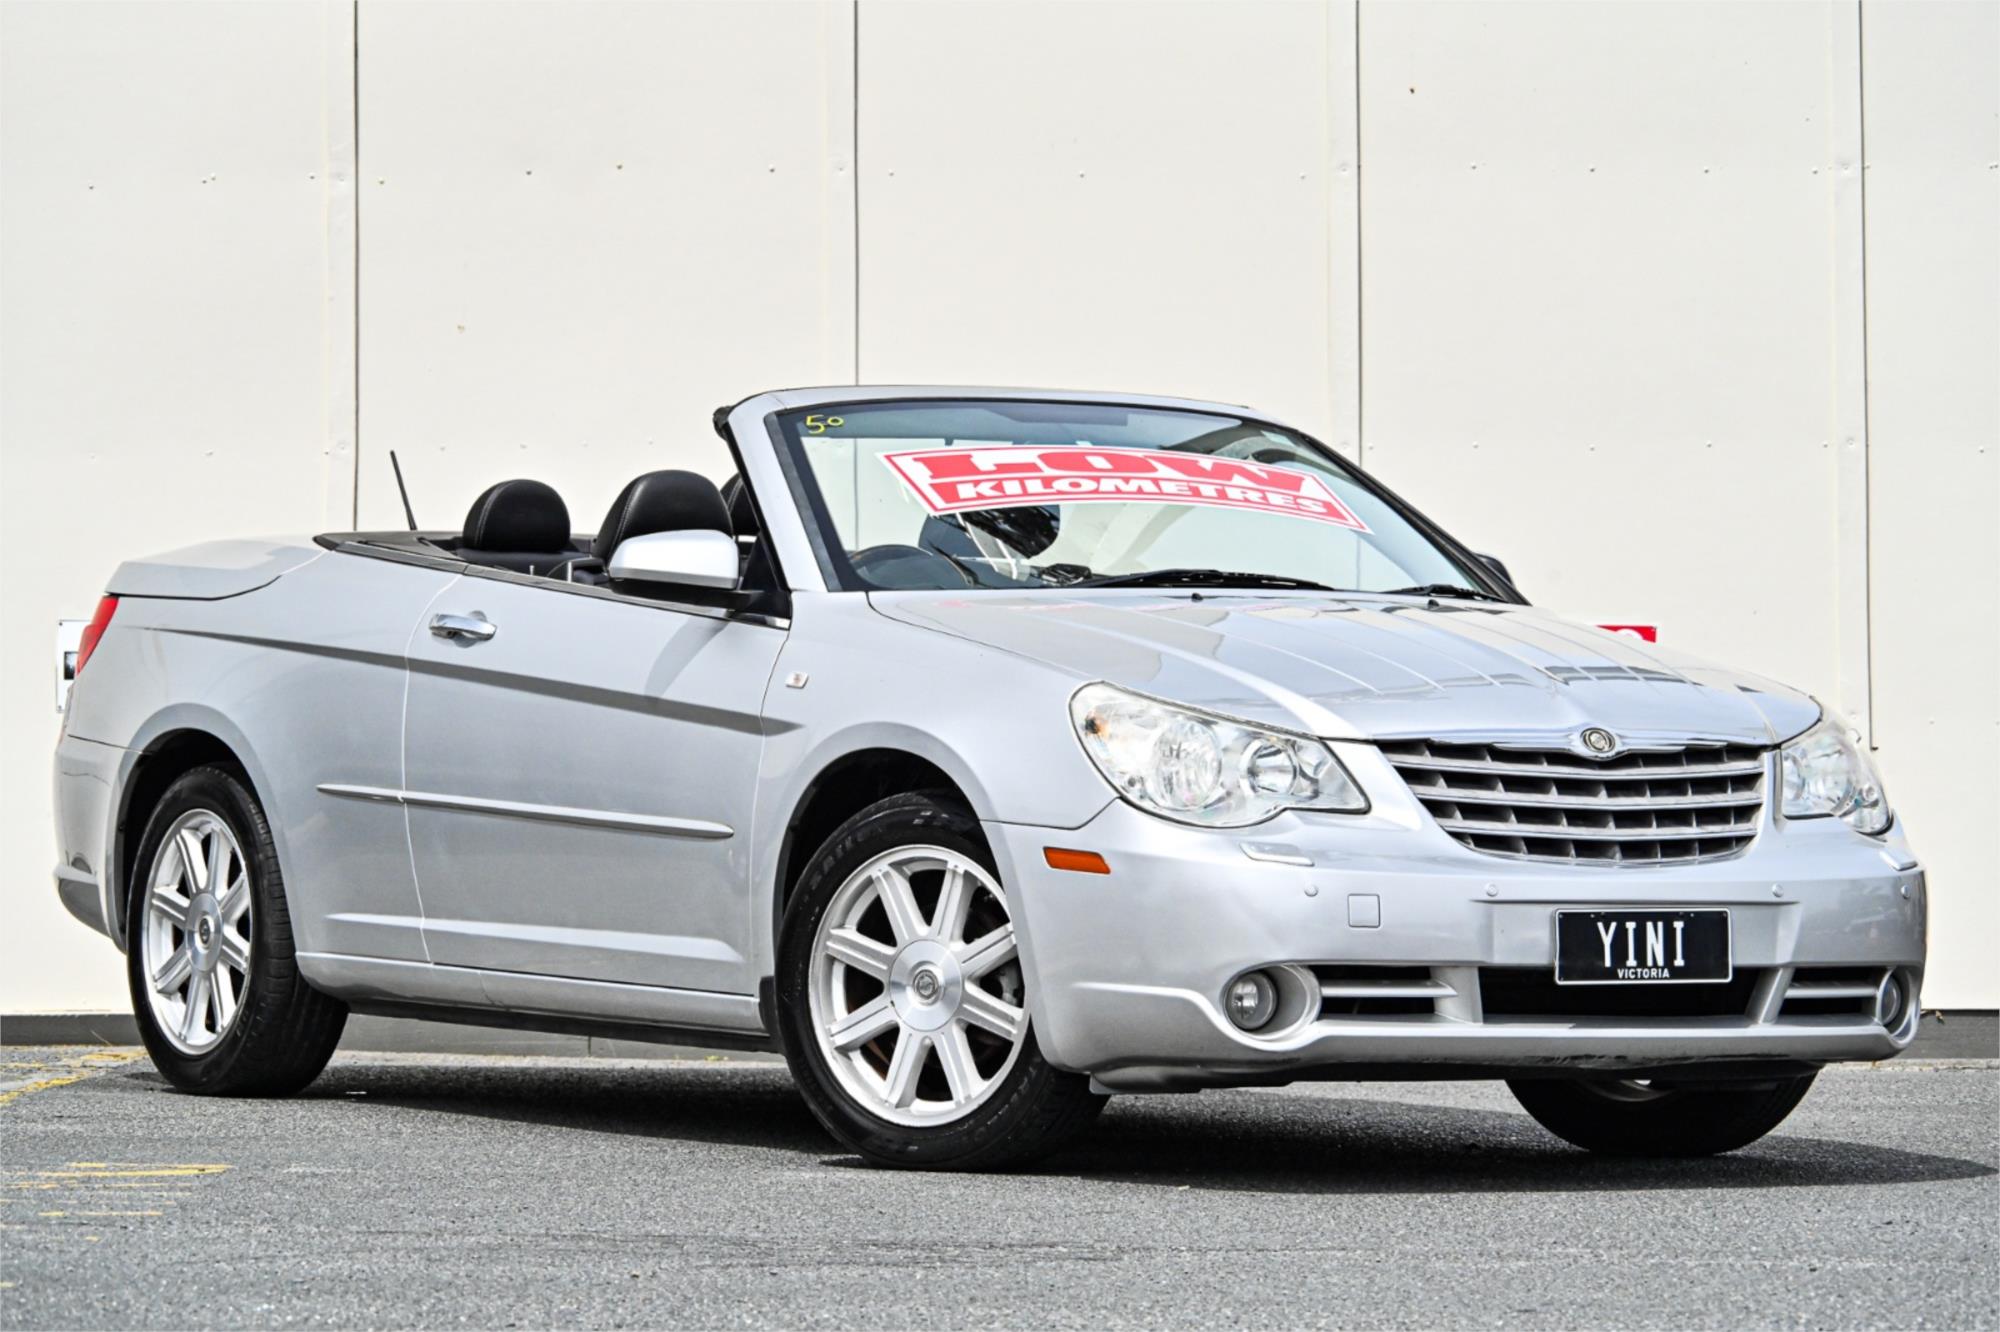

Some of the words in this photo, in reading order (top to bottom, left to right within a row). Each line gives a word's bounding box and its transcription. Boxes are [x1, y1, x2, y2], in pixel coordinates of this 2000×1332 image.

[806, 414, 844, 434] 50
[912, 452, 1305, 492] LOW
[955, 477, 1328, 513] KILOMETRES
[1596, 921, 1685, 967] YINI
[1617, 968, 1670, 979] VICTORIA
